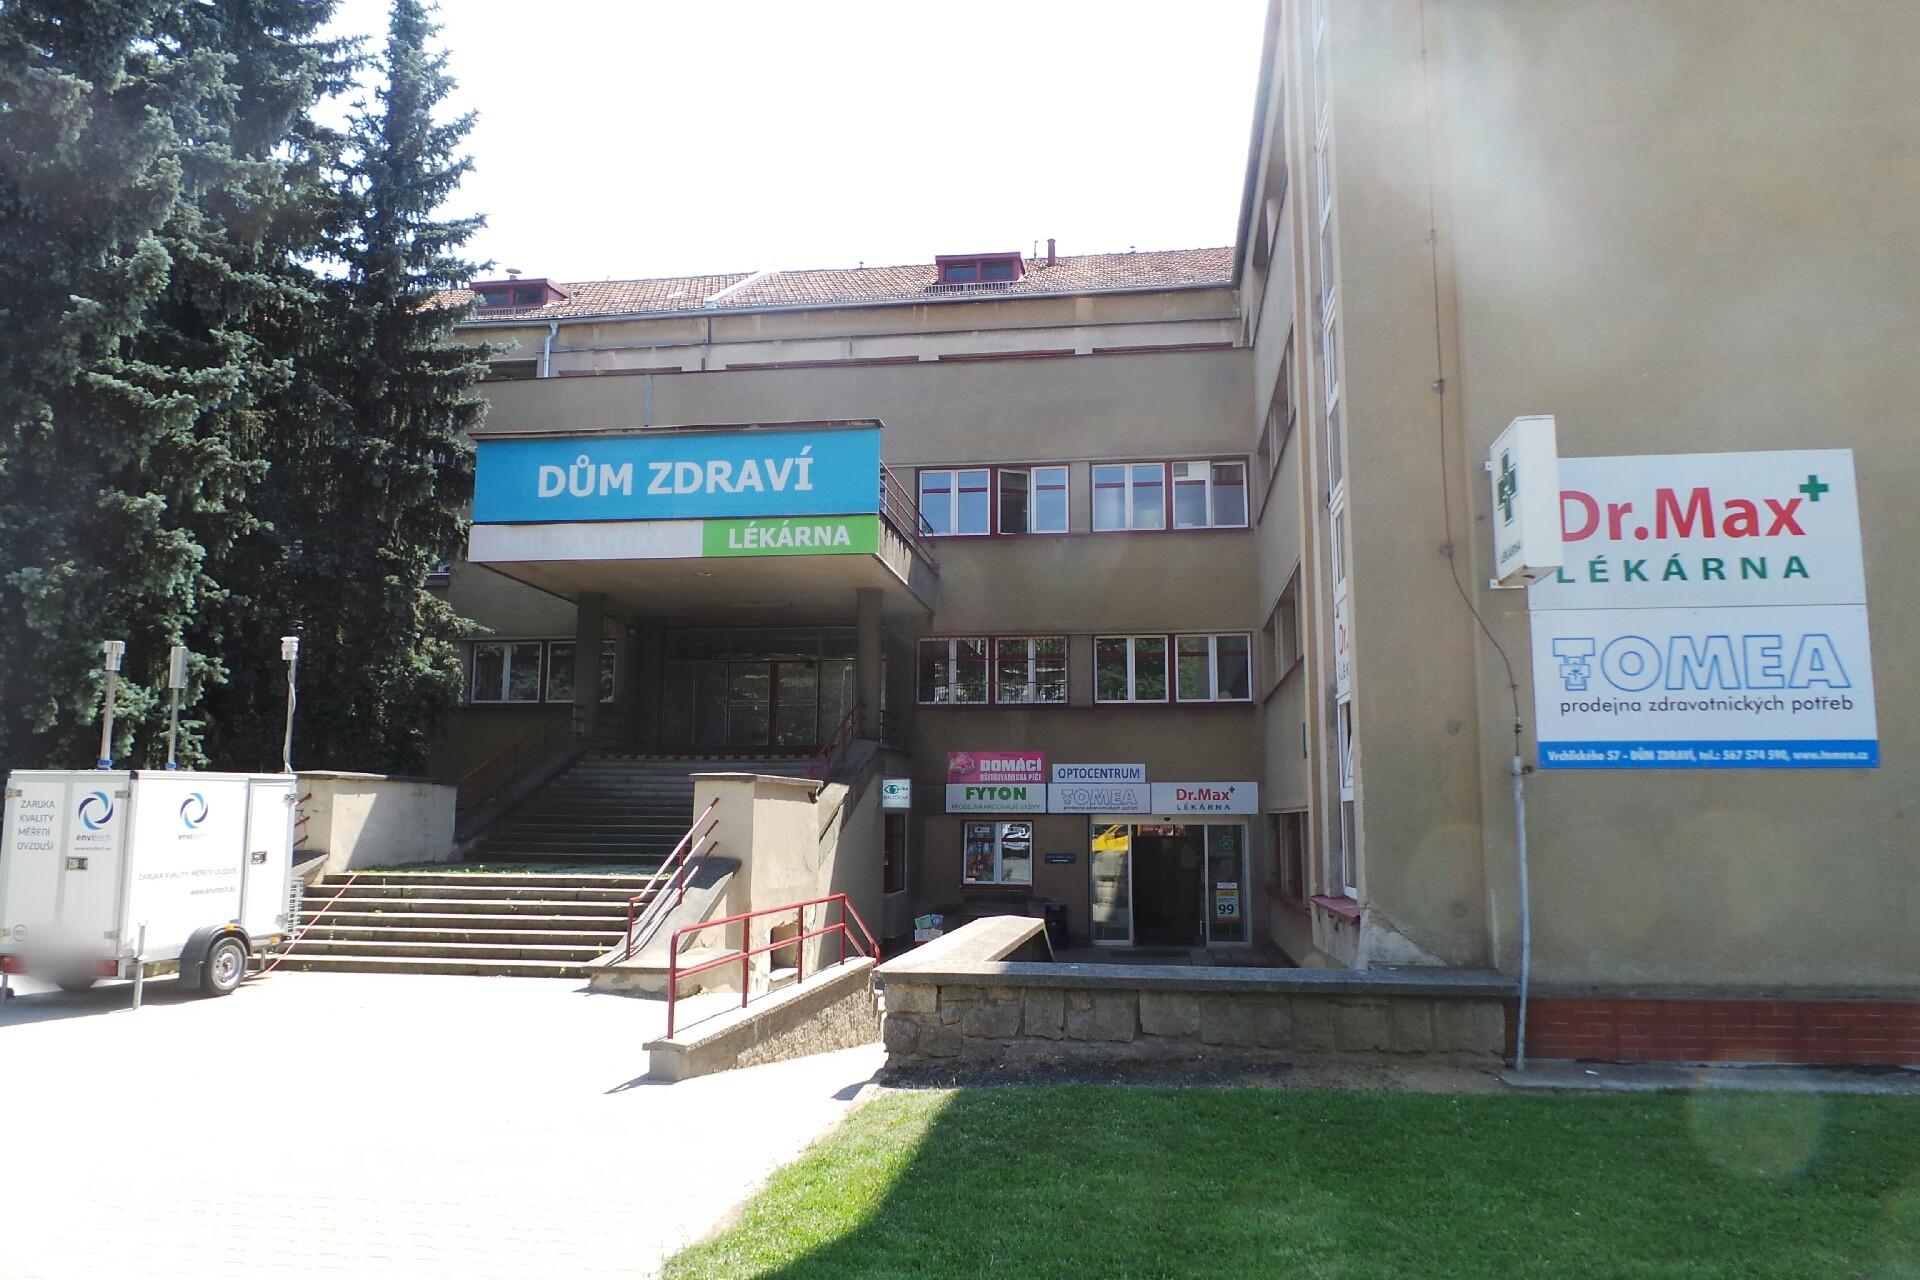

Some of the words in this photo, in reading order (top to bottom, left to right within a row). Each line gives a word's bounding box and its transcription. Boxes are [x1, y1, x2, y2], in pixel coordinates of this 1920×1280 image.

[538, 454, 633, 497] DŮM
[647, 445, 814, 495] ZDRAVÍ
[728, 520, 851, 549] LÉKÁRNA
[1556, 553, 1810, 583] LÉKÁRNA
[1552, 633, 1852, 692] TOMEA
[1560, 696, 1642, 715] prodejna
[1649, 694, 1785, 714] zdravotnických
[1792, 694, 1853, 712] potřeb
[1548, 750, 1605, 761] Vrchlického
[1607, 750, 1621, 761] 57
[1630, 747, 1654, 760] DŮM
[980, 757, 1042, 771] DOMÁCÍ
[1058, 768, 1140, 779] OPTOCENTRUM
[965, 786, 1027, 801] FYTON
[1061, 788, 1138, 805] TOMEA
[1176, 788, 1230, 801] Dr.Max
[20, 799, 55, 809] ZÁRUKA
[1176, 803, 1231, 811] LÉKÁRNA
[19, 814, 55, 822] KVALITY
[76, 833, 112, 842] envitech
[17, 841, 54, 850] OVZDUŠÍ
[1218, 903, 1234, 915] 99
